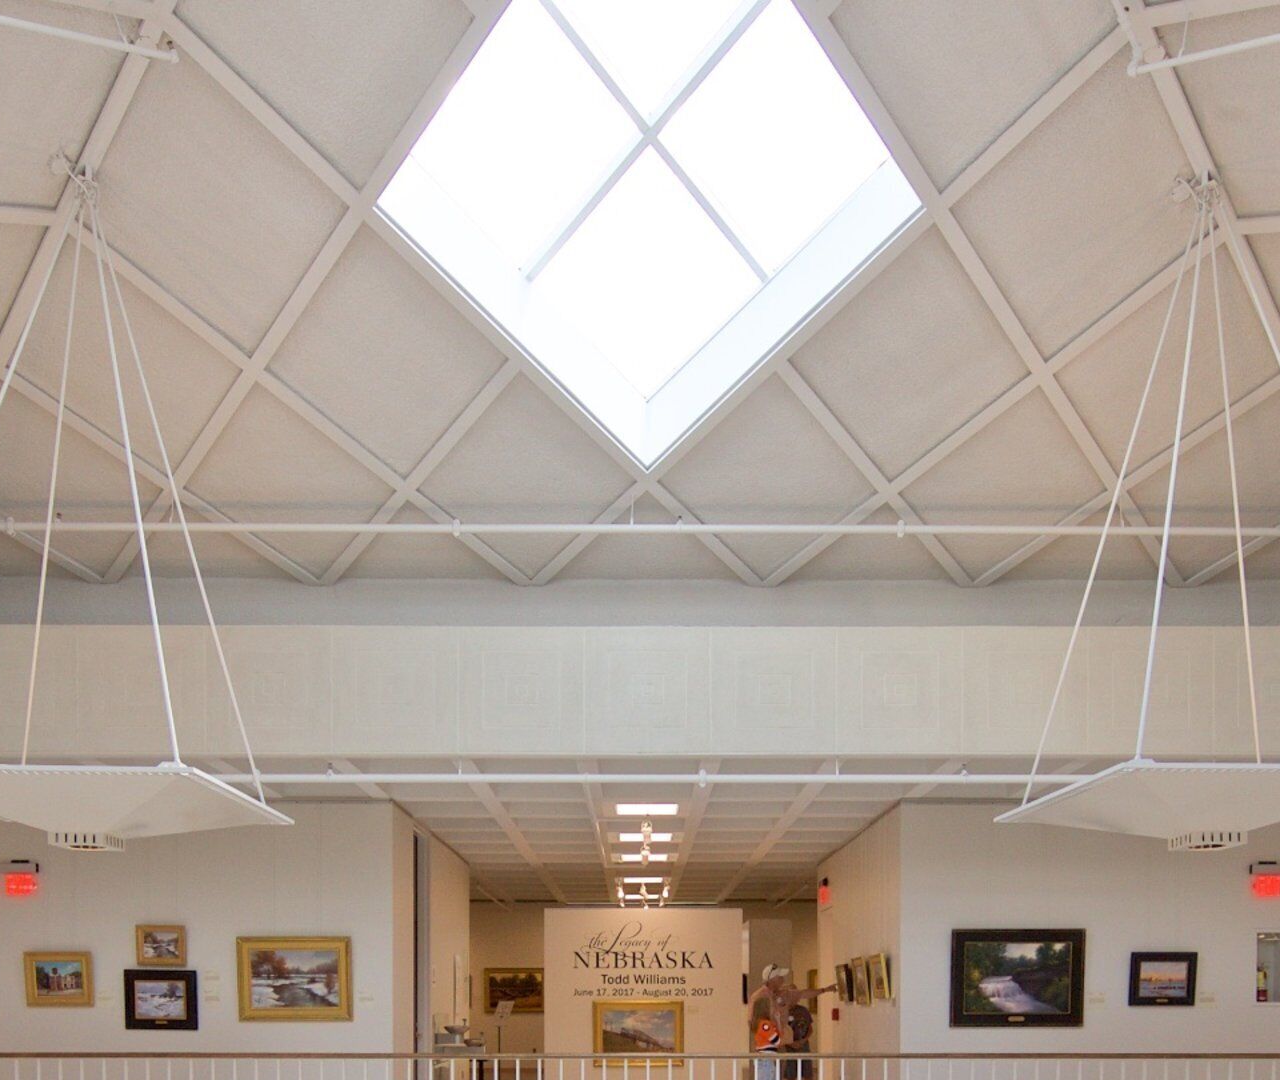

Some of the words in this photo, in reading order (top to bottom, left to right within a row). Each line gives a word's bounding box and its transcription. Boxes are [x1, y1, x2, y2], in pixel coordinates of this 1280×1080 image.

[586, 930, 608, 949] the
[604, 920, 652, 955] Legacy
[573, 950, 715, 969] NEBRASKA
[601, 973, 630, 985] Todd
[633, 973, 687, 985] Williams
[573, 987, 594, 997] June
[612, 987, 634, 996] 2017
[642, 987, 671, 998] August
[691, 987, 714, 997] 2017
